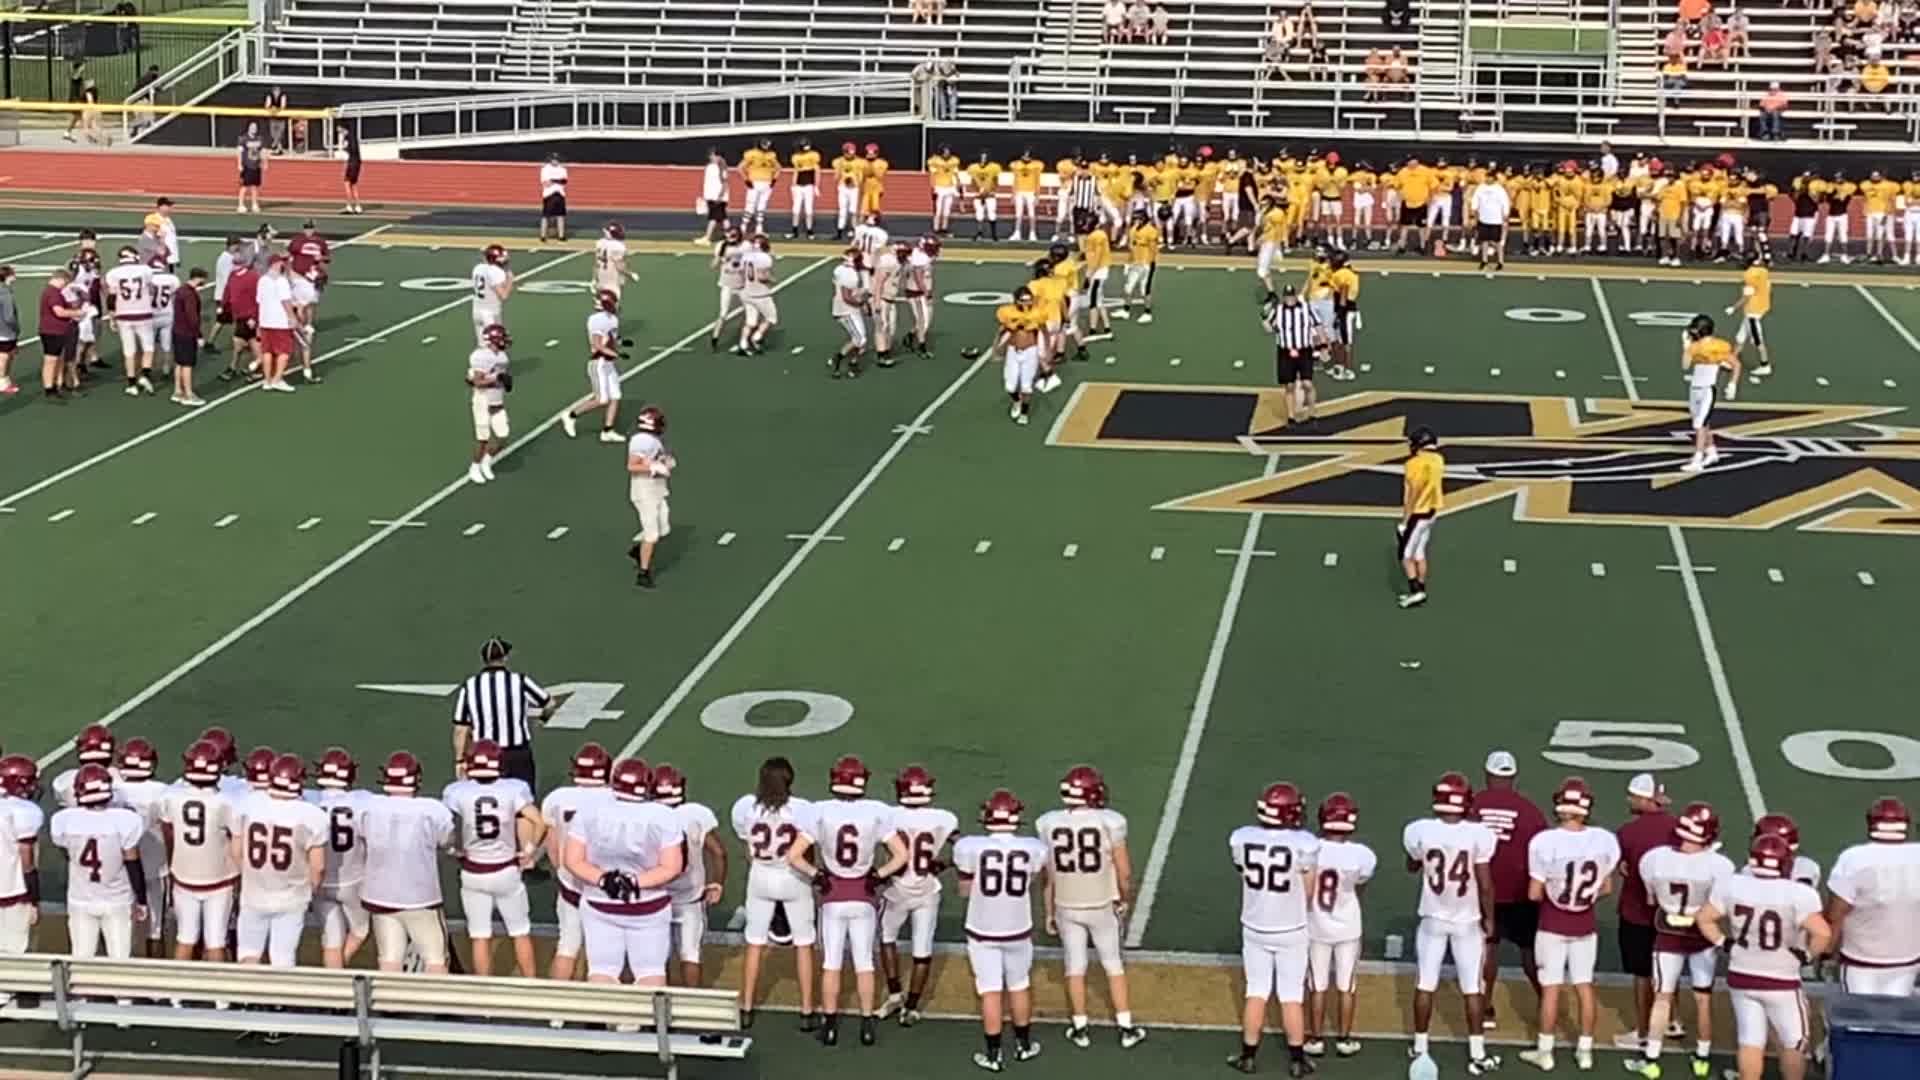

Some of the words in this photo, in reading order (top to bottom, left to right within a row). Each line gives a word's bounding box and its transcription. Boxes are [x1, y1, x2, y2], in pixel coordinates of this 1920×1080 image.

[119, 277, 143, 300] 57
[182, 800, 206, 846] 9
[475, 796, 501, 841] 6
[79, 838, 101, 882] 4
[248, 822, 293, 871] 65
[751, 823, 798, 861] 22
[835, 824, 859, 868] 6
[1052, 827, 1101, 873] 28
[979, 849, 1030, 898] 66
[1243, 842, 1293, 893] 52
[1426, 848, 1471, 897] 34
[1557, 860, 1598, 906] 12
[1669, 882, 1689, 915] 7
[1733, 903, 1782, 951] 70
